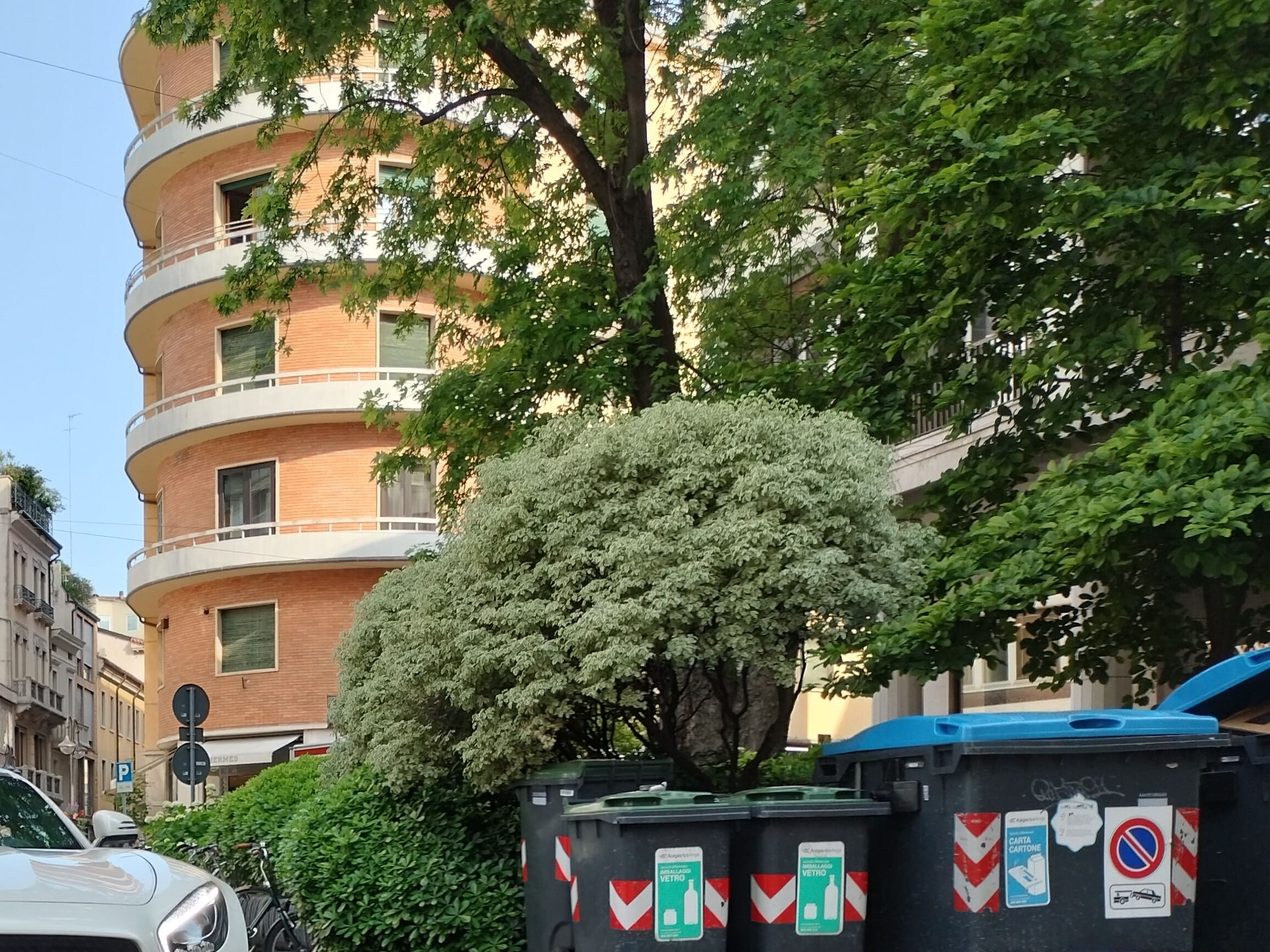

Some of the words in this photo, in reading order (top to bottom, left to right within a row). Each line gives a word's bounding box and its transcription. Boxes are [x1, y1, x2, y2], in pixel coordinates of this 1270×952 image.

[118, 764, 129, 781] P
[1009, 836, 1031, 845] CARTA
[1009, 844, 1041, 853] CARTONE
[802, 869, 827, 877] VETRO
[660, 874, 686, 883] VETRO
